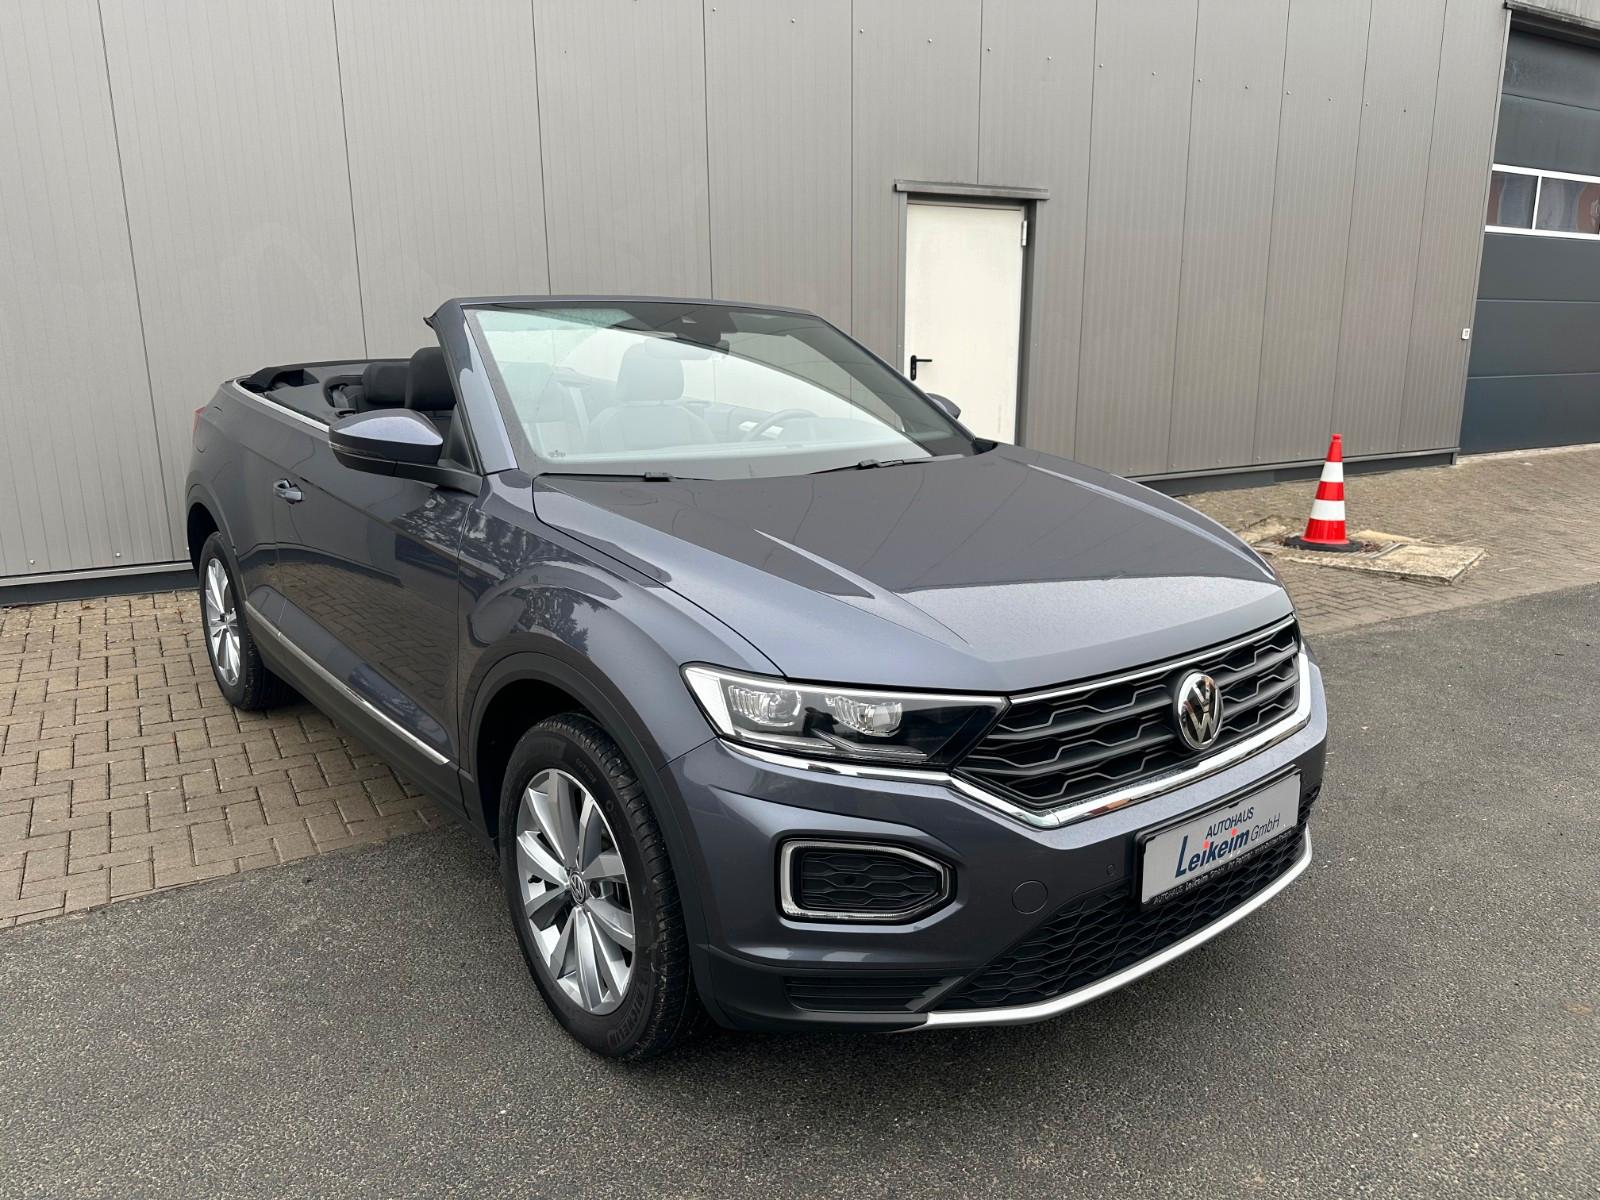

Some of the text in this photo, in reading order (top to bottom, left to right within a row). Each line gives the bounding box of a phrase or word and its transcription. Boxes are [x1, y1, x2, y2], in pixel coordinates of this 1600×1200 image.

[1174, 827, 1251, 878] Leikeim
[1250, 812, 1281, 842] GmbH
[1205, 806, 1255, 839] AUTOHAUS
